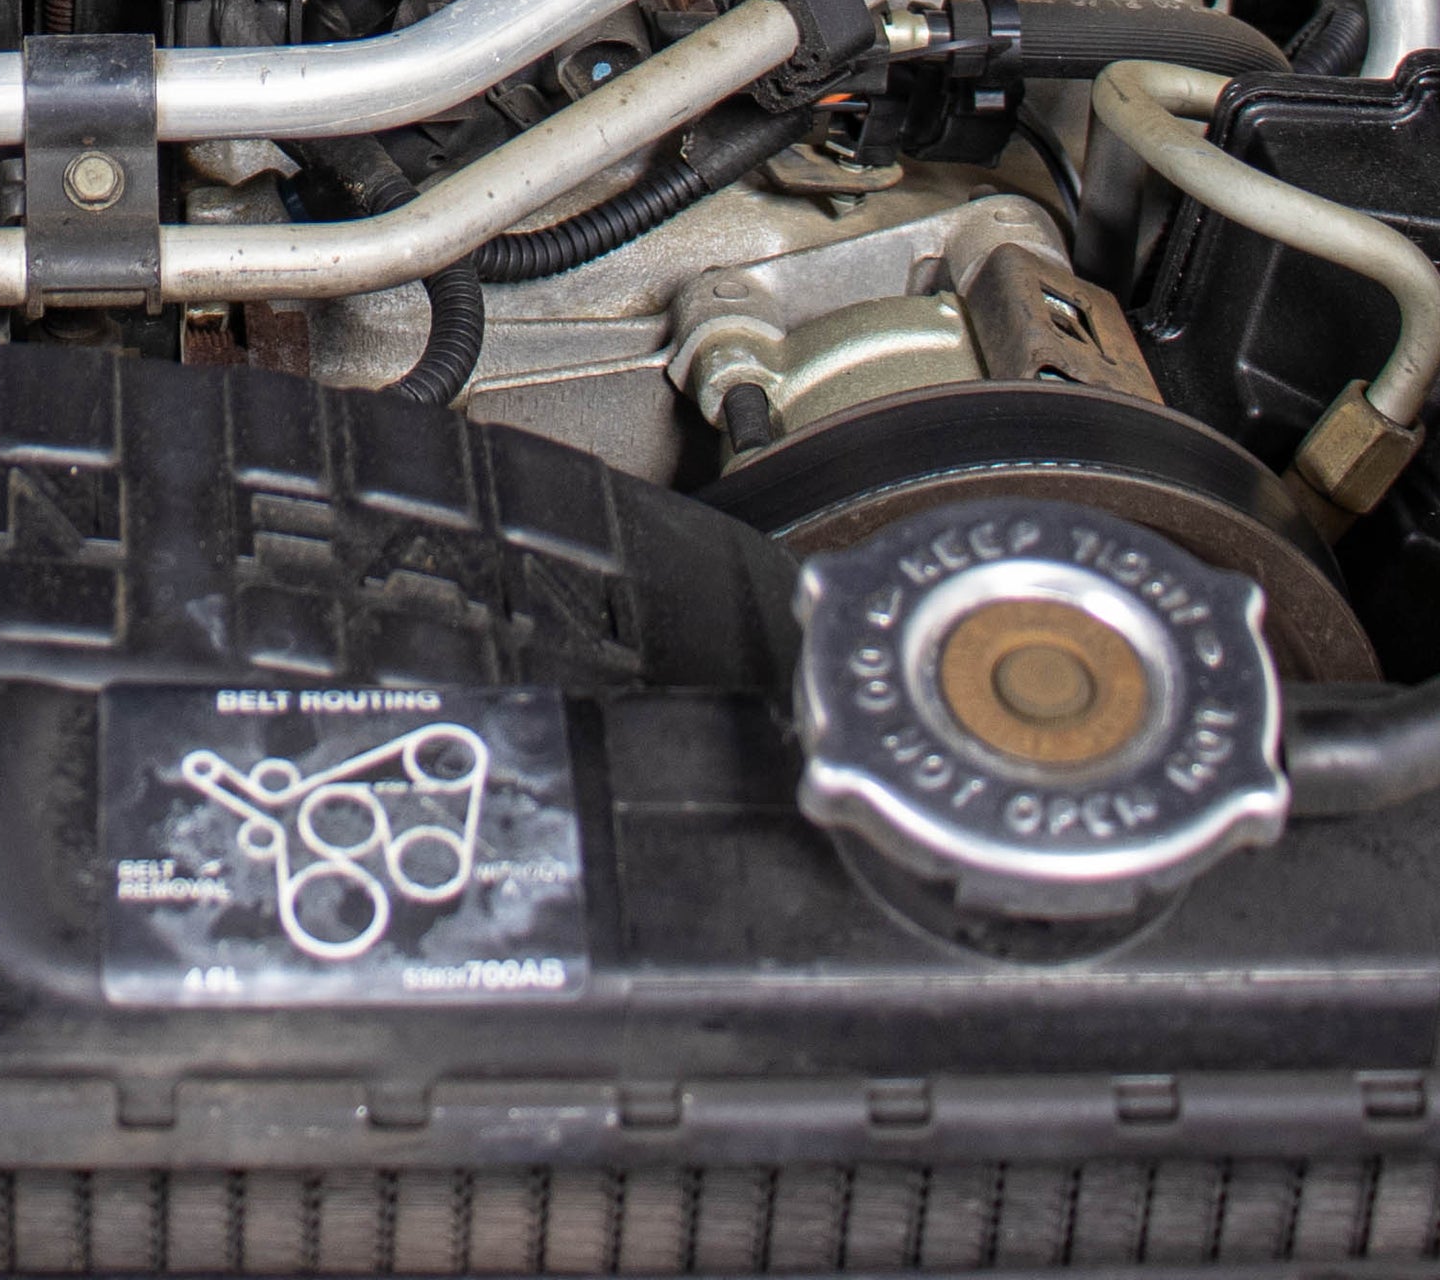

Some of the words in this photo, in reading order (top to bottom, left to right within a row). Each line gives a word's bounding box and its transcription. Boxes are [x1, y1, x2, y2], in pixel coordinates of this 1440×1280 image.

[215, 689, 289, 712] BELT
[299, 690, 442, 713] ROUTING
[117, 859, 176, 878] BELT
[117, 878, 232, 901] REMOVAL
